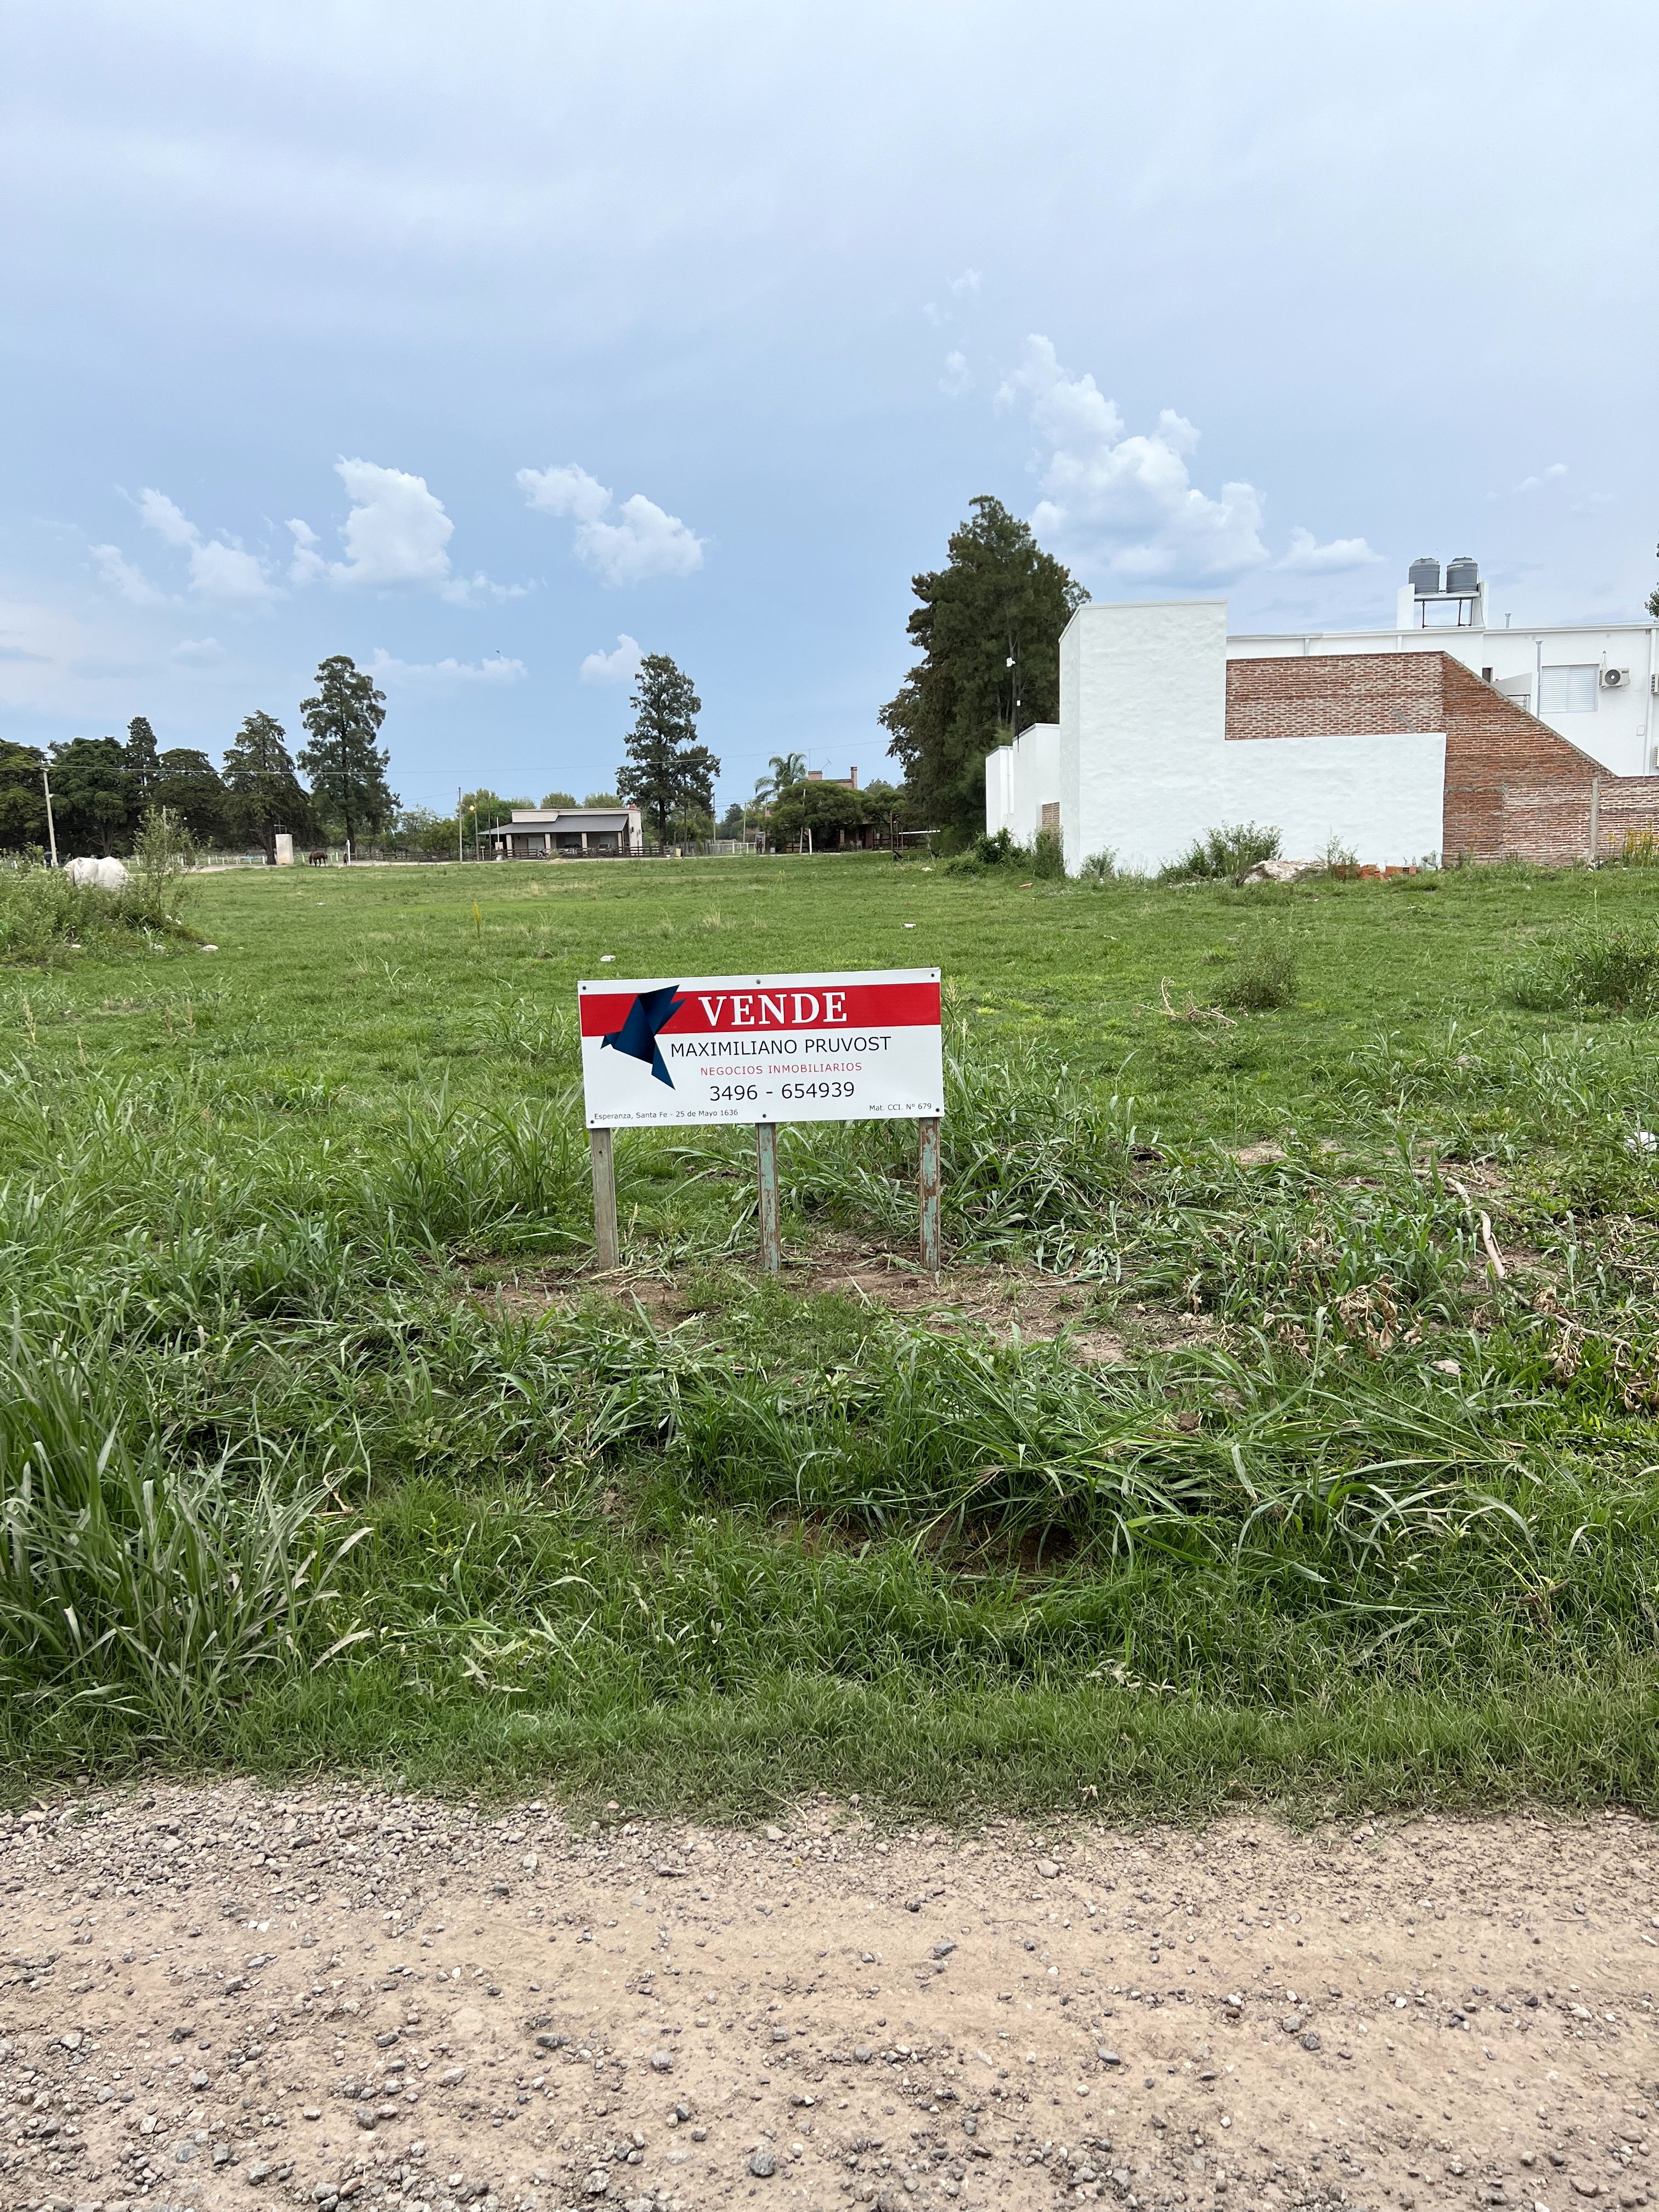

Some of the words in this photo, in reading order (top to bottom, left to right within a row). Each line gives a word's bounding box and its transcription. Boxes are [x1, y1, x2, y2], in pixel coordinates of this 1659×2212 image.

[698, 991, 847, 1026] VENDE
[671, 1040, 797, 1058] MAXIMILIANO
[805, 1036, 891, 1053] PRUVOST
[701, 1065, 763, 1076] NEGOCIOS
[768, 1062, 862, 1074] INMOBILIARIOS
[710, 1084, 758, 1102] 3496
[781, 1081, 855, 1099] 654939
